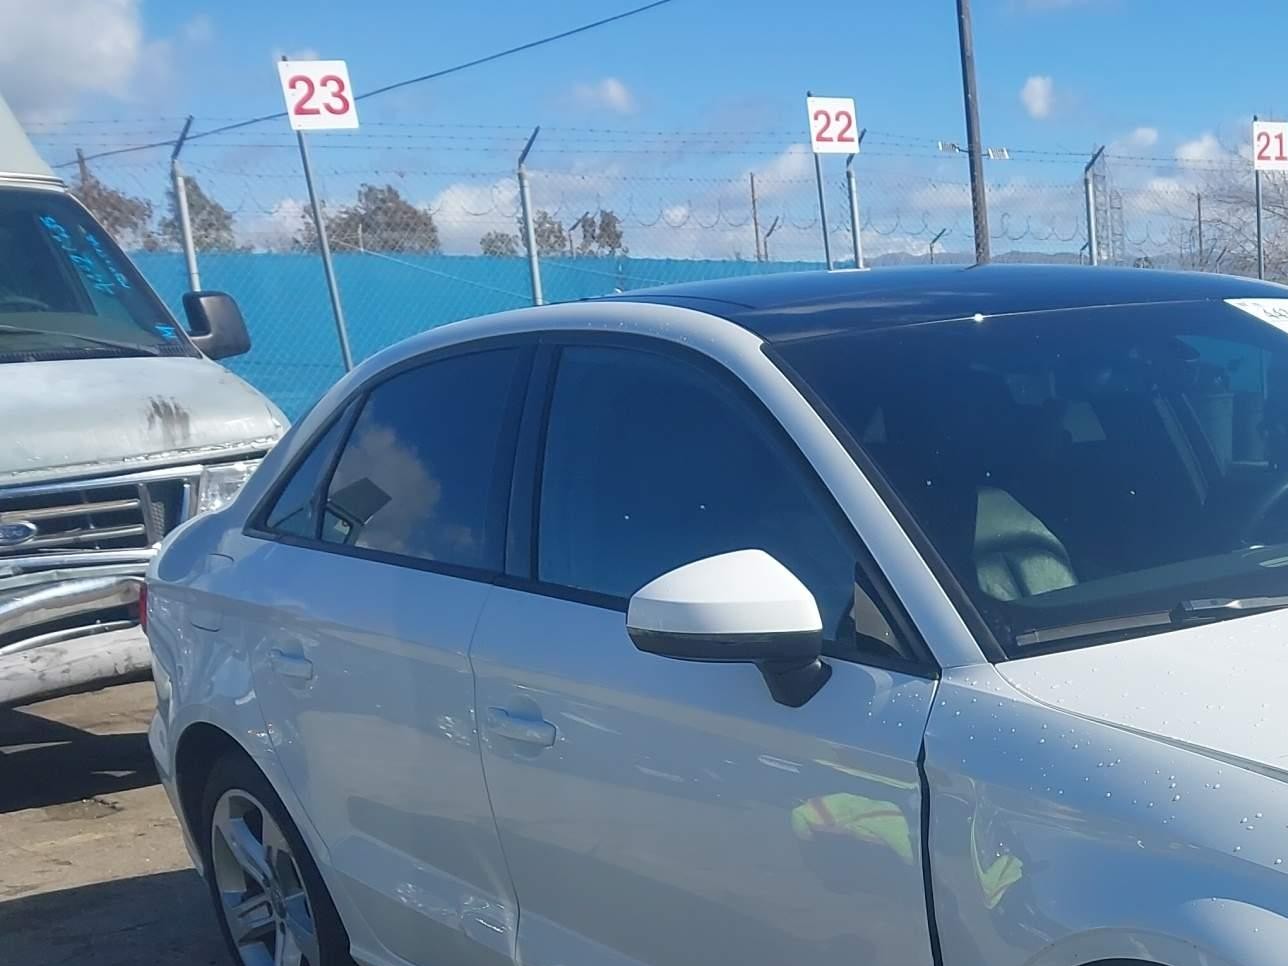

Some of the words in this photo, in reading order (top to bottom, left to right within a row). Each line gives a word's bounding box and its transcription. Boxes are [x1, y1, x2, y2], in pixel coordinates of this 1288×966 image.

[287, 74, 350, 117] 23
[813, 109, 853, 143] 22
[1257, 131, 1288, 161] 21
